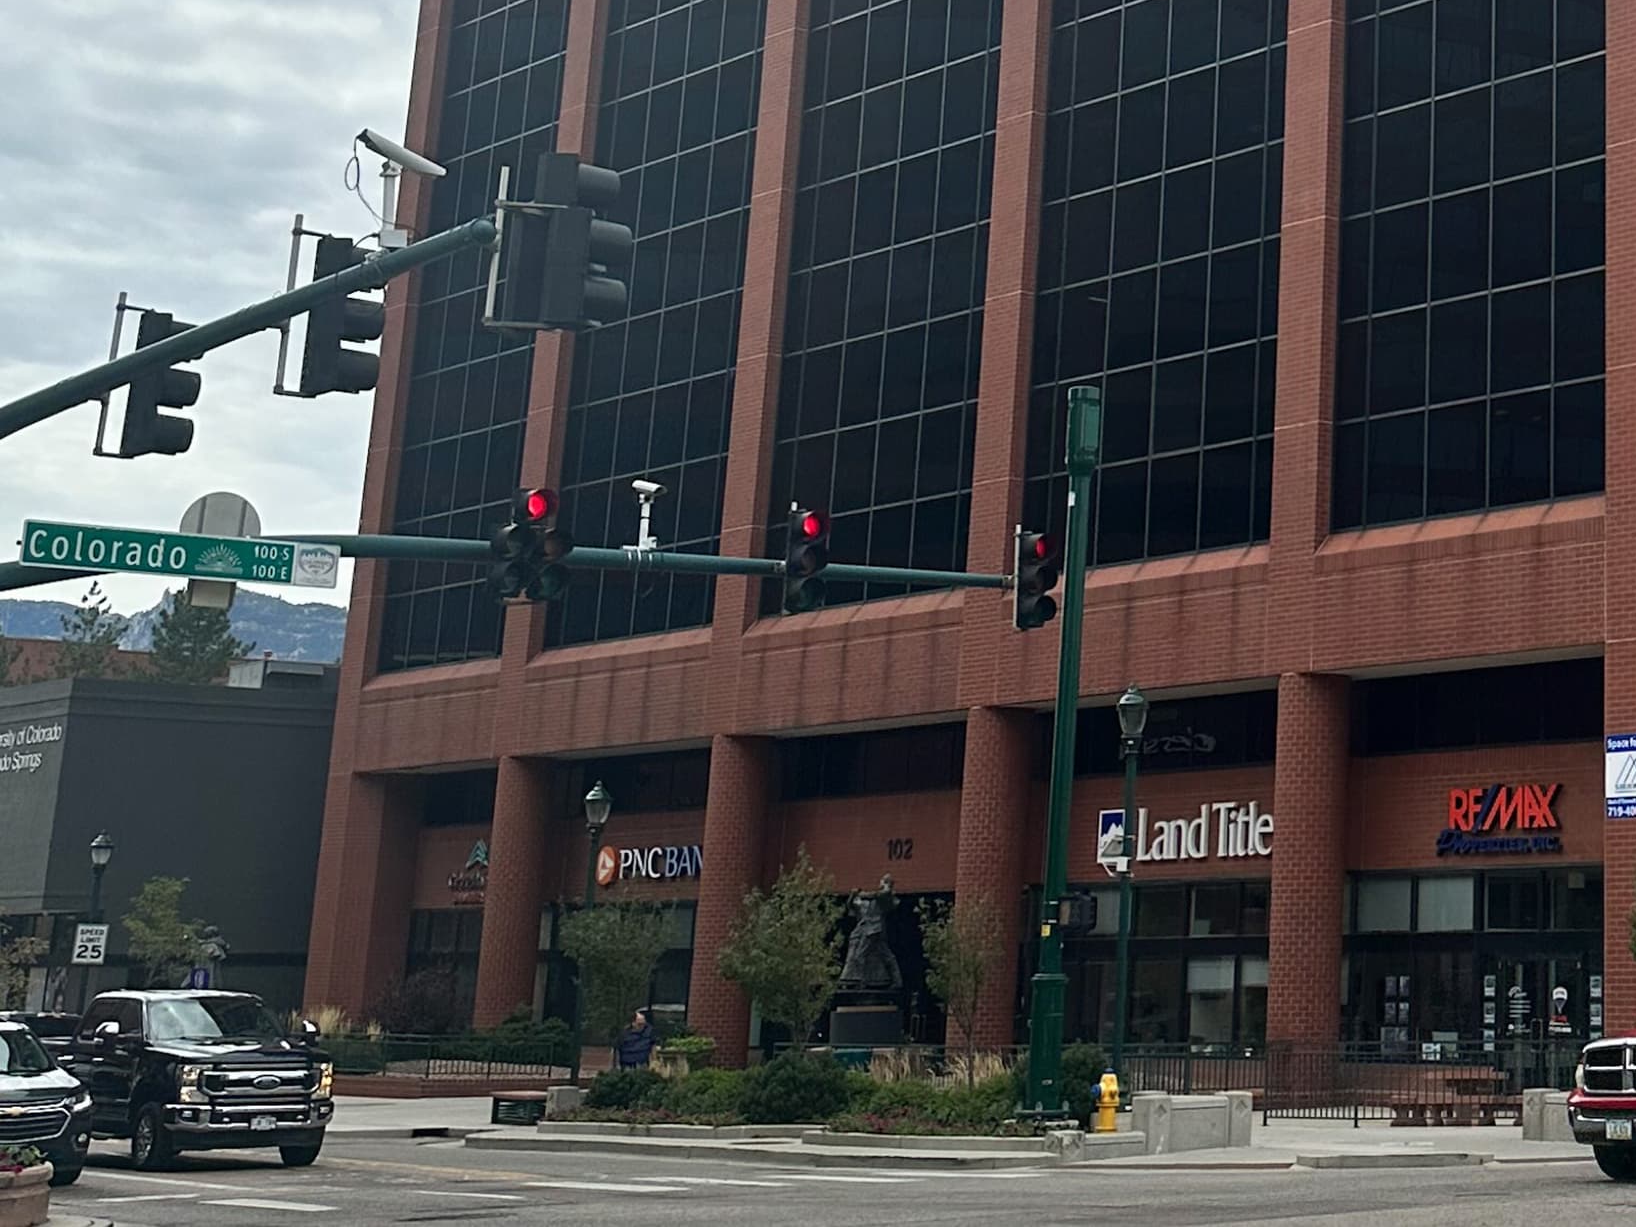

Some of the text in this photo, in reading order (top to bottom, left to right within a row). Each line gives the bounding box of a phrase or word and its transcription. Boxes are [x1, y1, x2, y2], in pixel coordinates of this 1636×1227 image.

[29, 529, 187, 569] Colorado
[254, 544, 290, 561] 100 S
[252, 564, 288, 580] 100 E
[26, 722, 62, 744] Colorado
[1607, 737, 1630, 750] Space
[1448, 783, 1558, 832] RE/MAX
[1136, 800, 1274, 861] Land Title
[888, 837, 913, 861] 102
[619, 847, 662, 879] PNC
[80, 928, 104, 936] SPEED
[76, 944, 102, 959] 25
